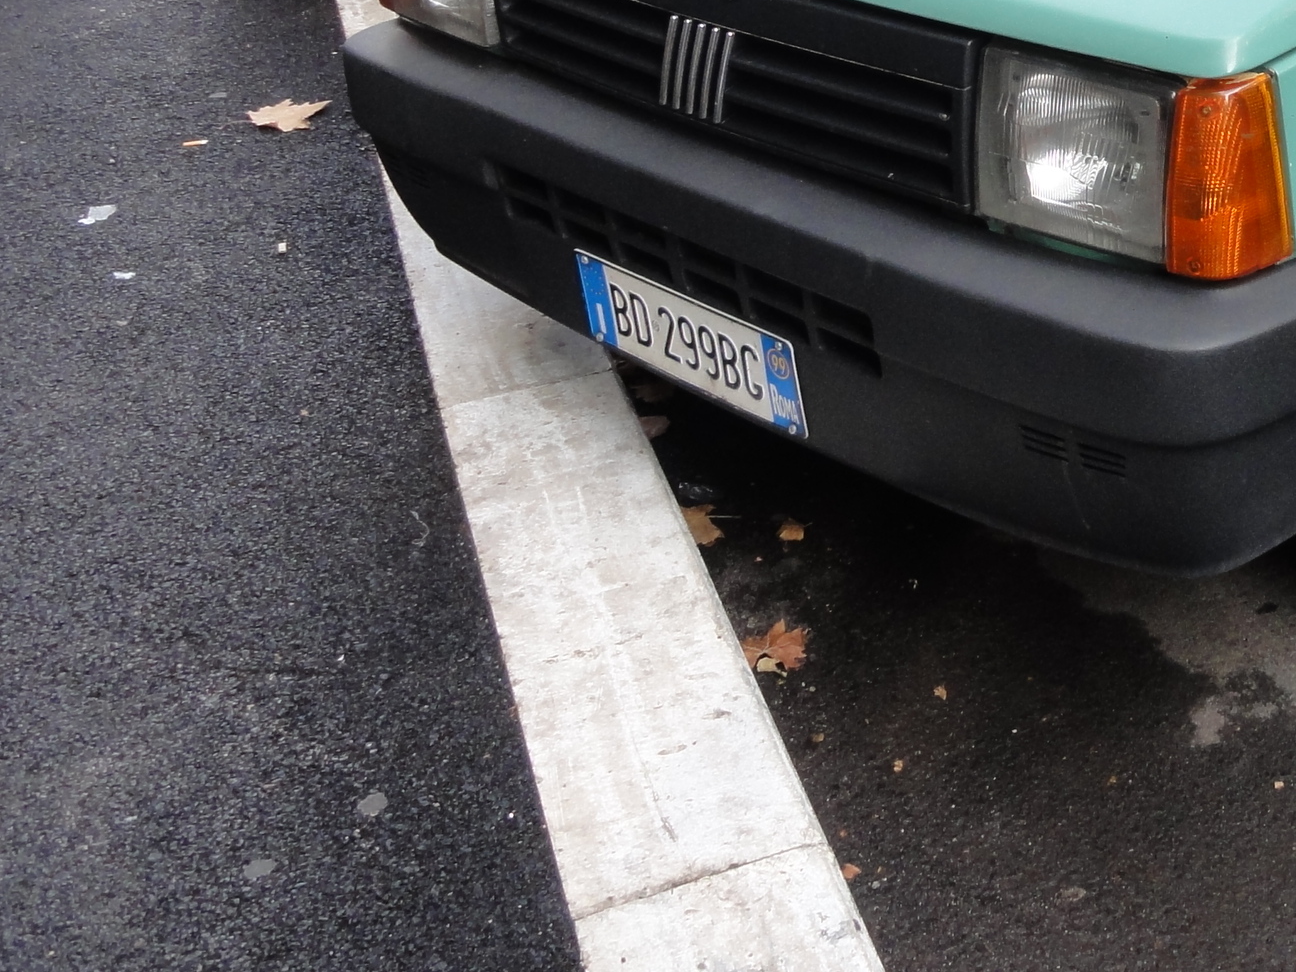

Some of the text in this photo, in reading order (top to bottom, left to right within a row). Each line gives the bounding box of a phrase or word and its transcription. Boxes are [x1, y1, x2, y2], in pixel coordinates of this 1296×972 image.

[609, 282, 653, 347] BD
[658, 306, 764, 400] 299BG
[771, 355, 786, 372] 99
